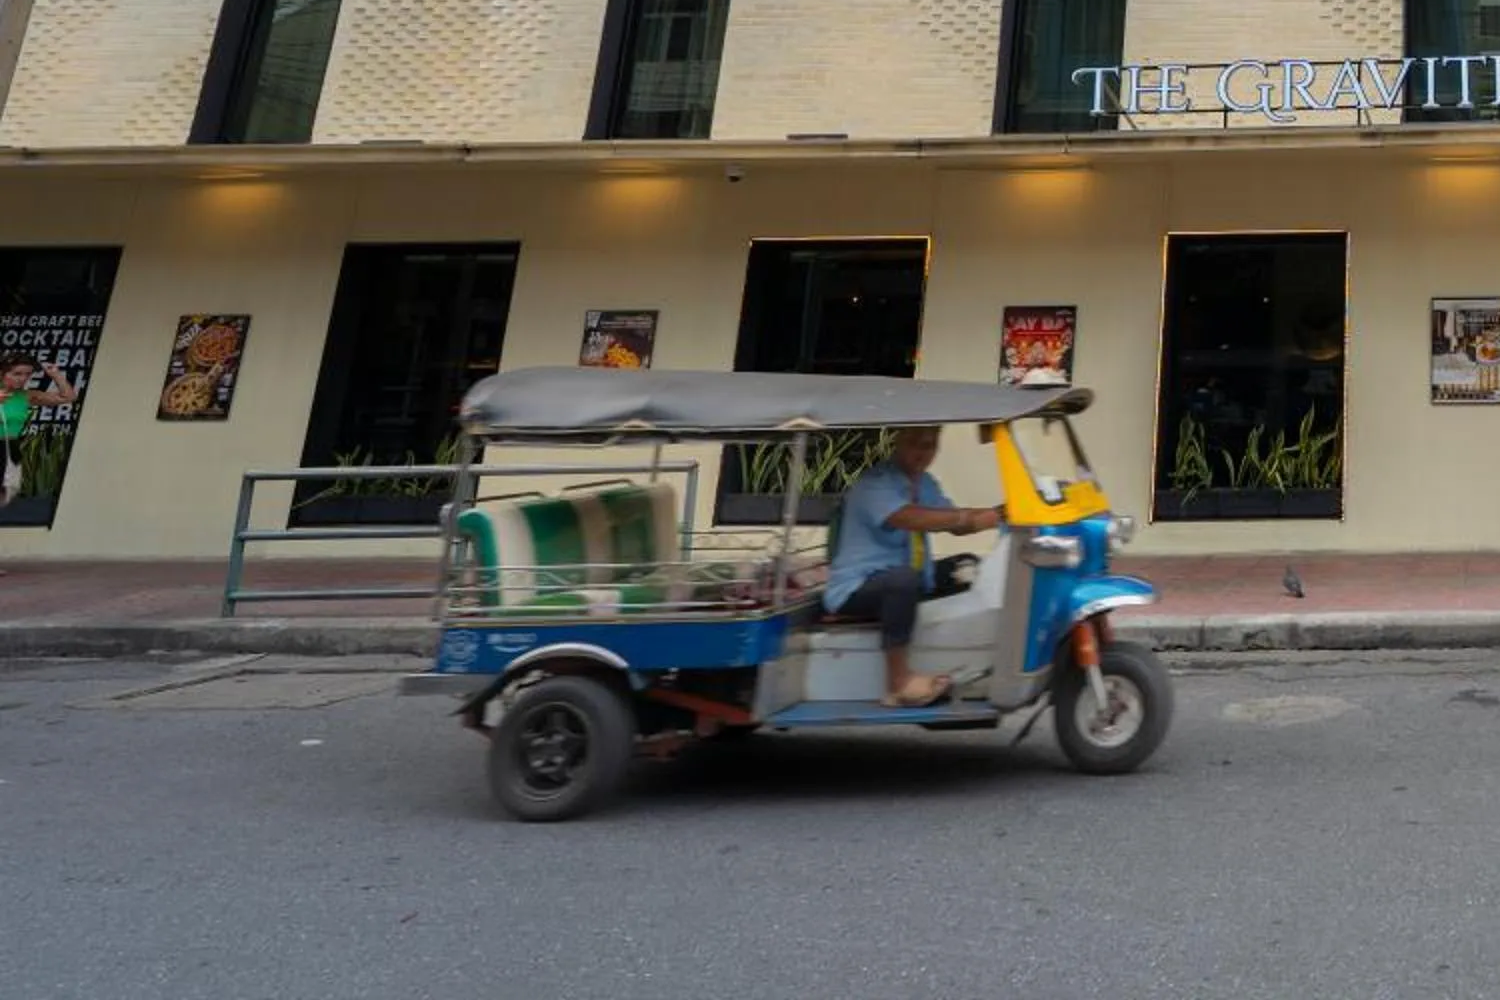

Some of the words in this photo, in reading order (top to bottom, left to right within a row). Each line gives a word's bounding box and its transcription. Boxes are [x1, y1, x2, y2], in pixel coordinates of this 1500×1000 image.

[1071, 64, 1190, 117] THE
[28, 315, 77, 328] CRAFT
[0, 329, 98, 347] OCKTAIL
